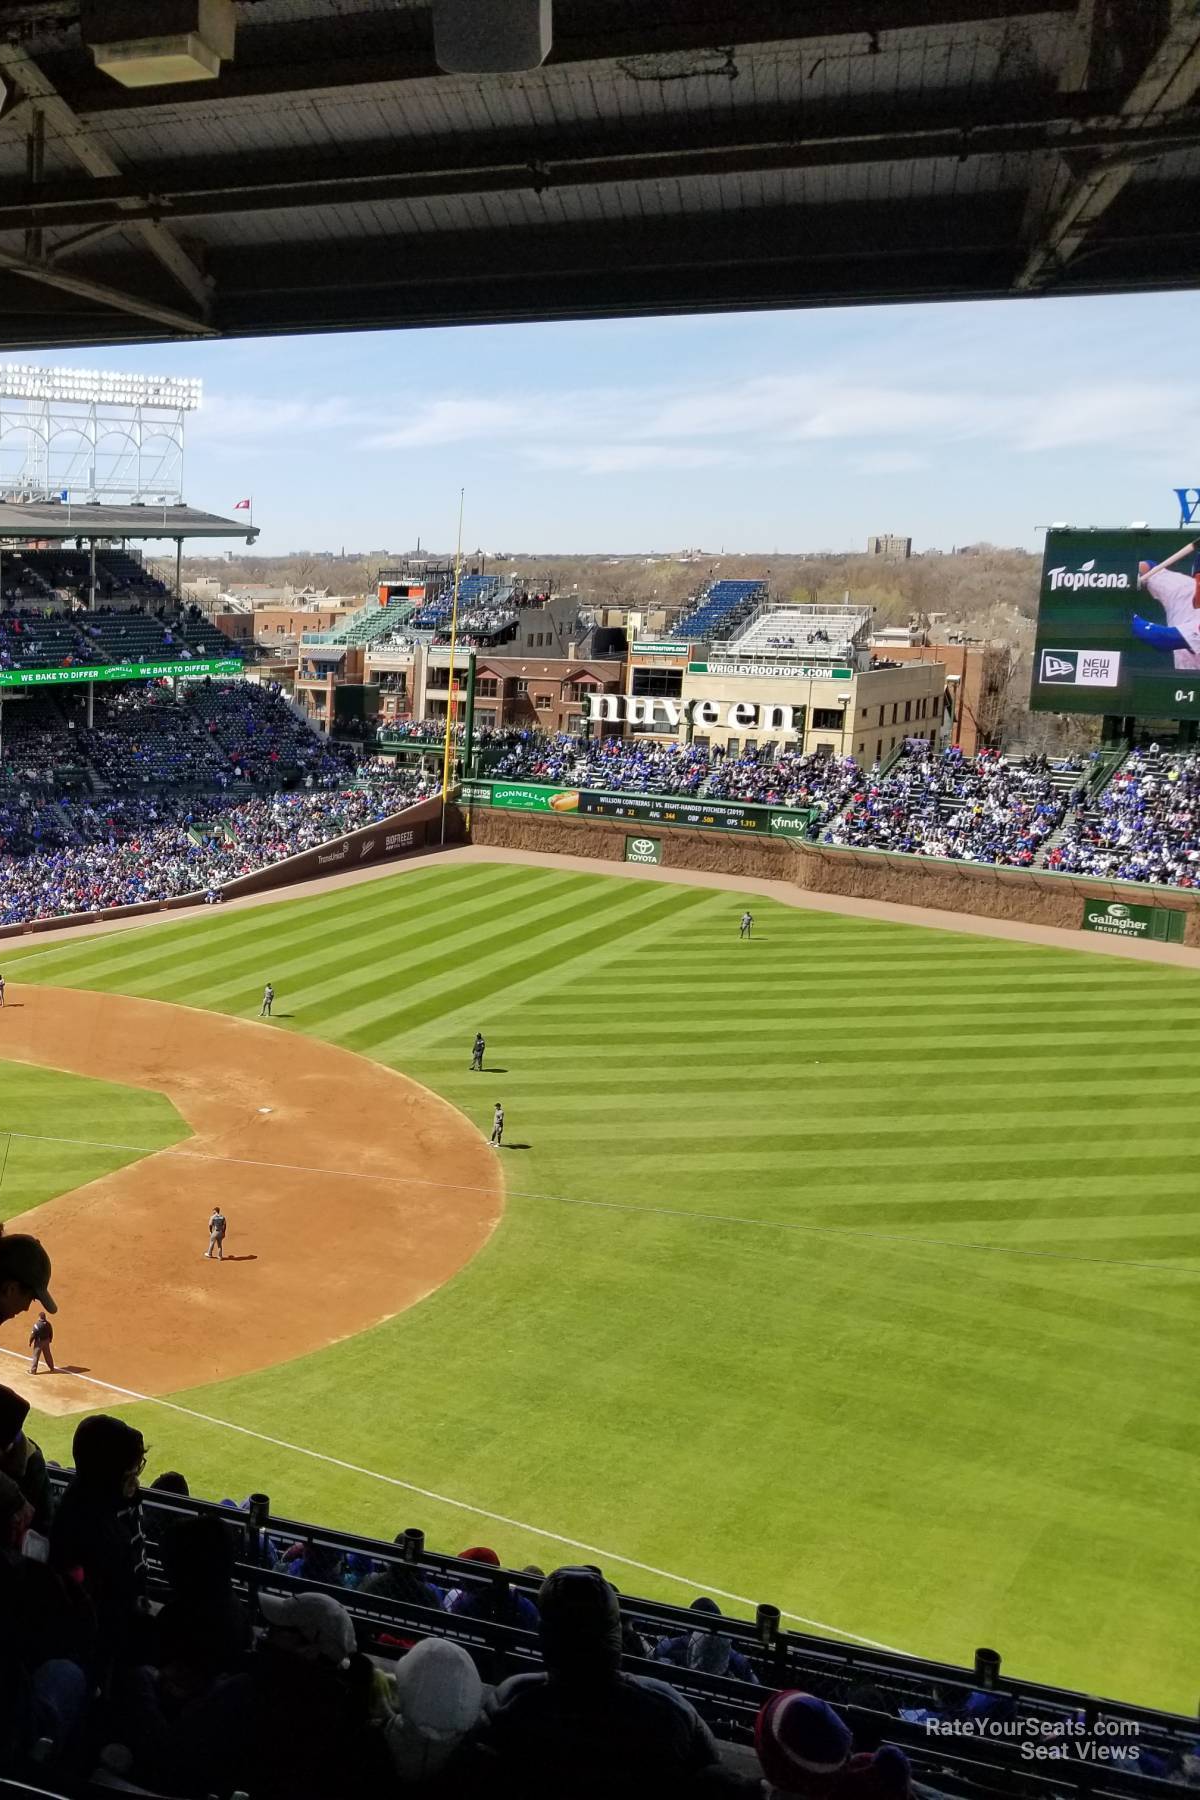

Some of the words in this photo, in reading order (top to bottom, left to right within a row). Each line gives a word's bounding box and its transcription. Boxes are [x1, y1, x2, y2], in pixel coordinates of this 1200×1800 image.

[1048, 566, 1127, 592] Tropicana
[140, 667, 151, 675] WE
[153, 666, 172, 674] BAKE
[174, 665, 183, 673] TO
[184, 664, 210, 672] DIFFER
[1083, 658, 1110, 668] NEW
[21, 674, 33, 682] WE
[35, 673, 57, 681] BAKE
[71, 670, 99, 679] DIFFER
[706, 663, 833, 678] WRIGLEYROOFTOPS.COM
[1082, 668, 1109, 678] ERA
[1175, 690, 1195, 702] 0-1
[586, 693, 799, 733] nuveen
[495, 790, 546, 803] GONNELLA
[600, 796, 622, 804] WILLSON
[622, 799, 650, 807] CONTRERAS
[664, 802, 702, 812] RIGHT-HANDED
[703, 806, 726, 814] PITCHERS
[726, 818, 738, 826] OPS
[770, 816, 806, 830] xfinity
[386, 831, 414, 845] BIOFREEZE
[318, 851, 345, 865] TransUnion
[627, 853, 657, 863] TOYOTA
[1088, 913, 1148, 930] Gallagher
[1095, 925, 1138, 936] INSURANCE
